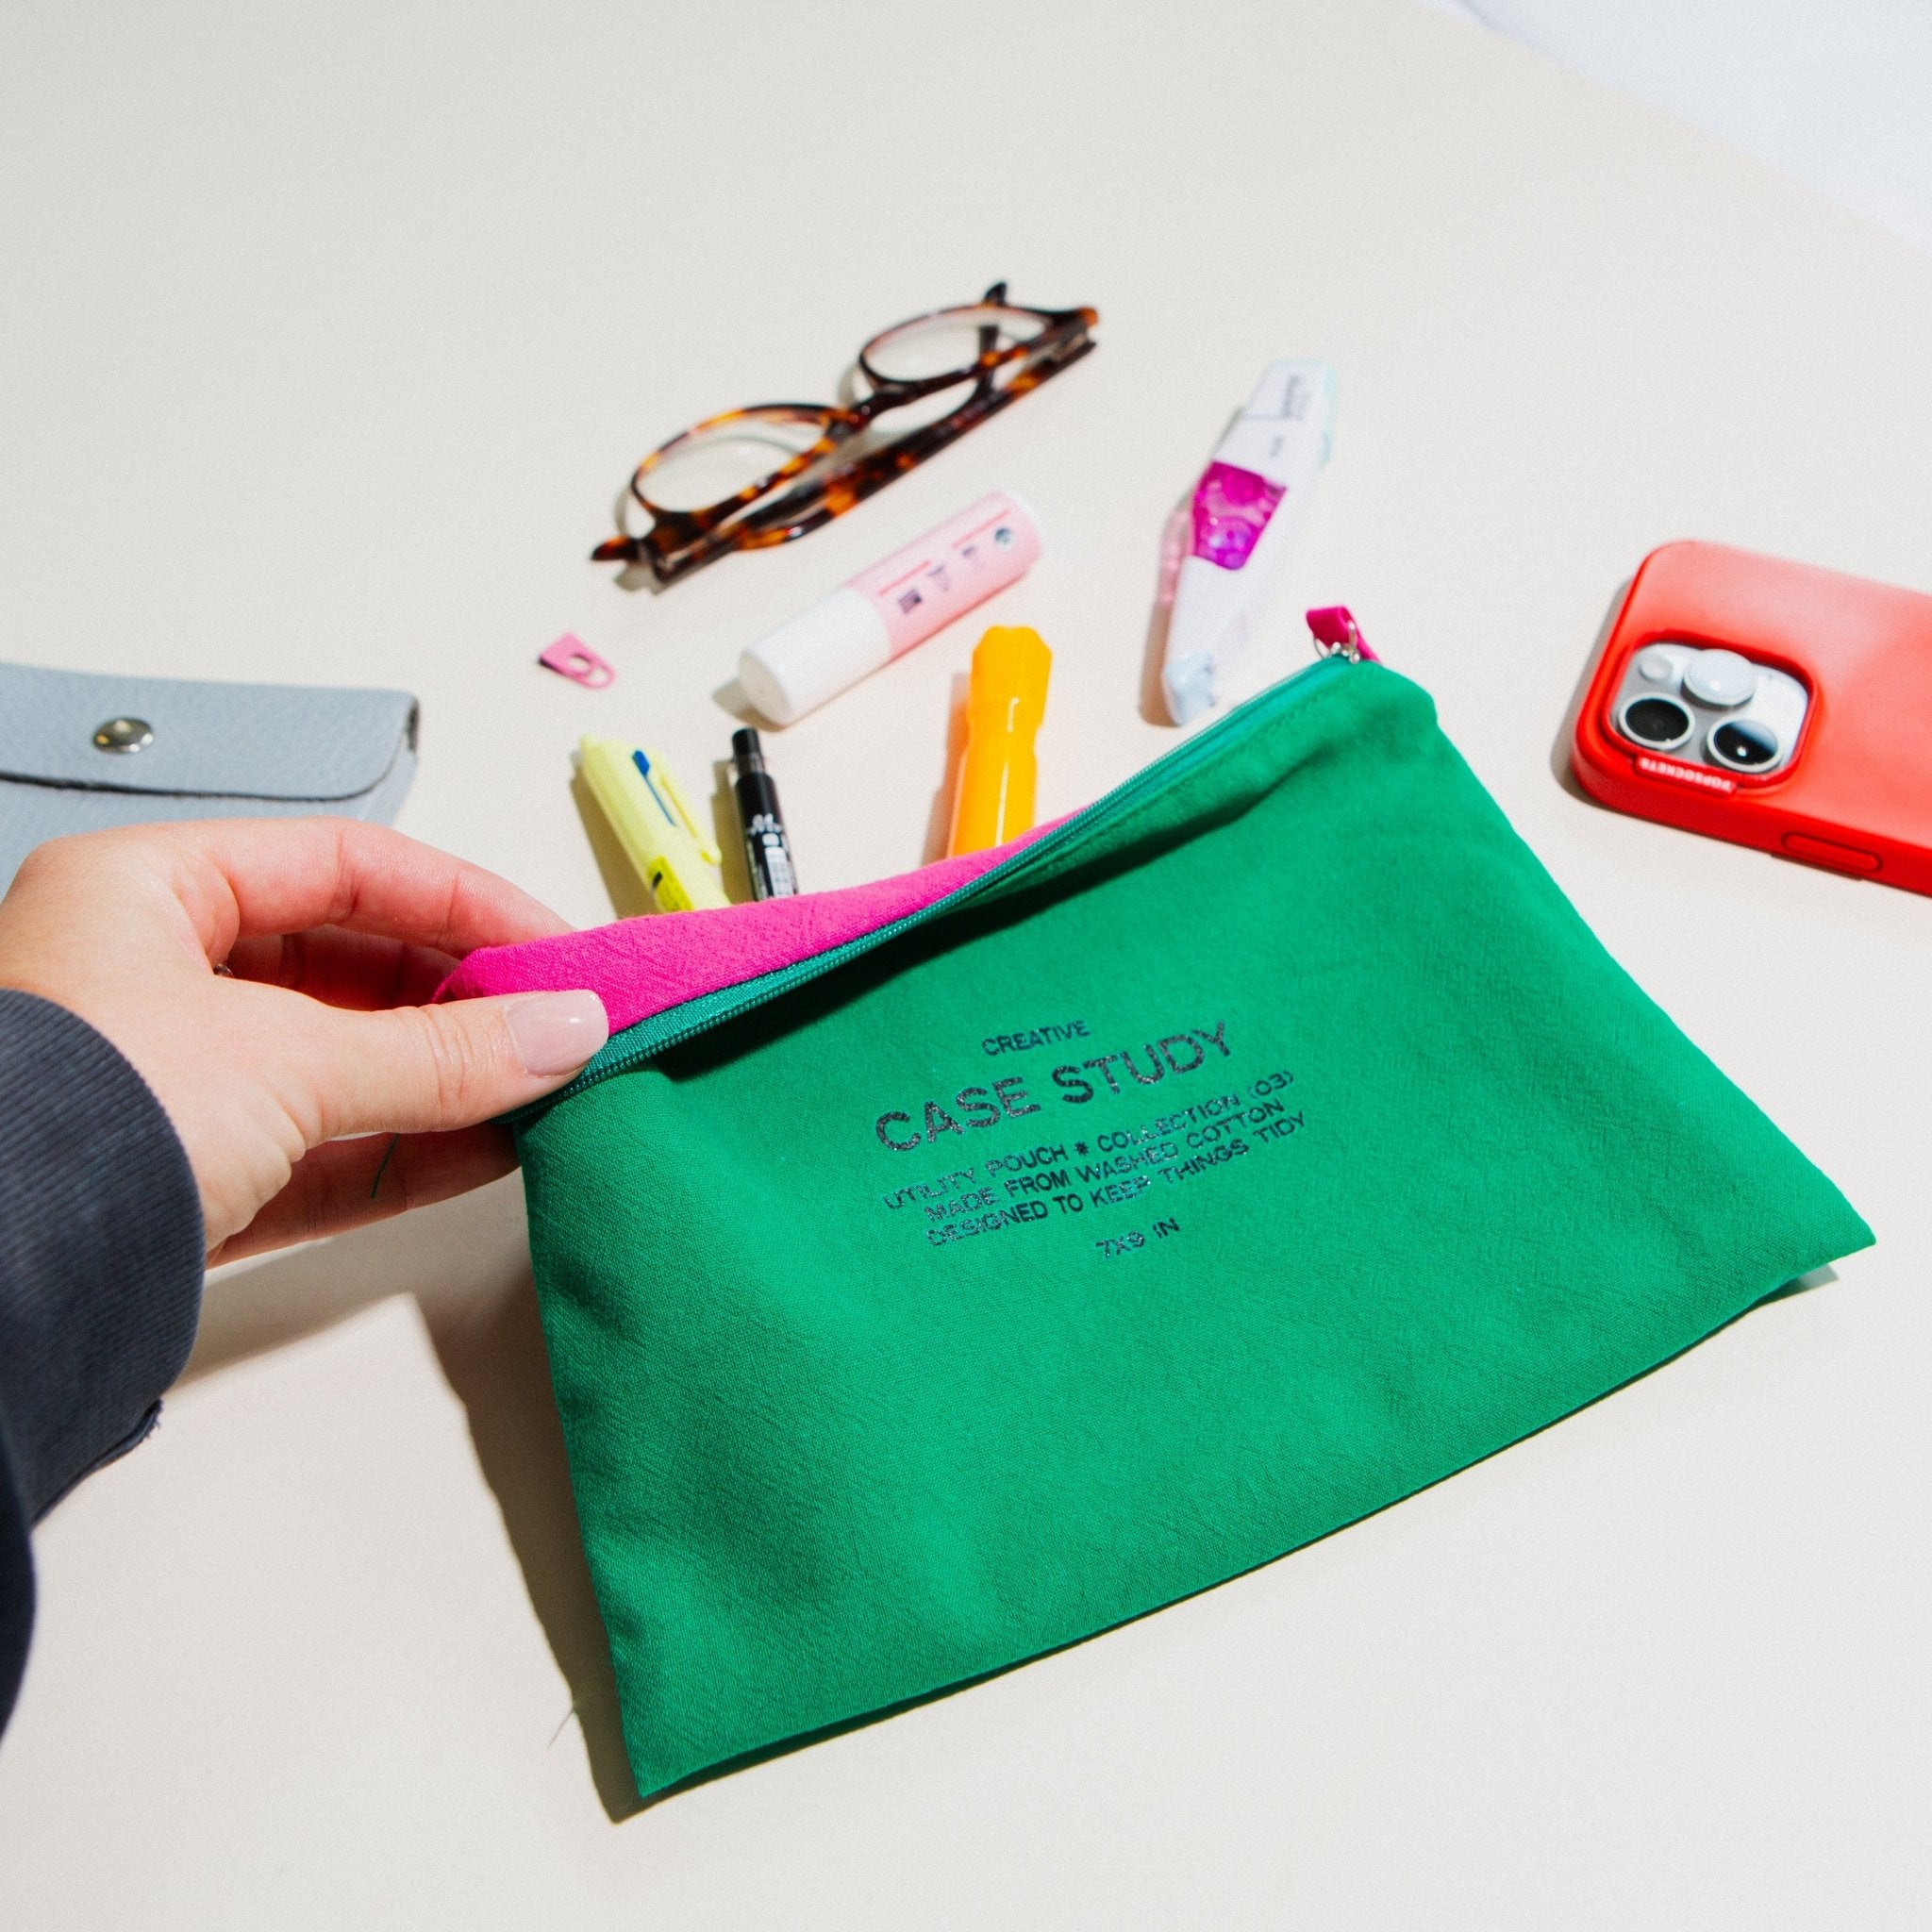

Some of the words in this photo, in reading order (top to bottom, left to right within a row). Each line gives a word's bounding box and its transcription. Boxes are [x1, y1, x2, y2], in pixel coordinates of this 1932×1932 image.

[875, 1076, 1041, 1152] CASE
[1052, 1021, 1231, 1104] STUDY
[981, 1020, 1091, 1057] CREATIVE
[883, 1167, 976, 1210] UTILITY
[985, 1143, 1069, 1177] POUCH
[1097, 1093, 1241, 1152] COLLECTION
[924, 1186, 1000, 1223] MADE
[1004, 1169, 1073, 1197] FROM
[1074, 1142, 1179, 1183] WASHED
[1186, 1098, 1285, 1149] COTTON
[925, 1200, 1049, 1246] DESIGNED
[1052, 1192, 1084, 1215] TO
[1089, 1175, 1152, 1208] KEEP
[1157, 1139, 1250, 1184] THINGS
[1253, 1110, 1306, 1143] TIDY
[1152, 1217, 1180, 1240] IN
